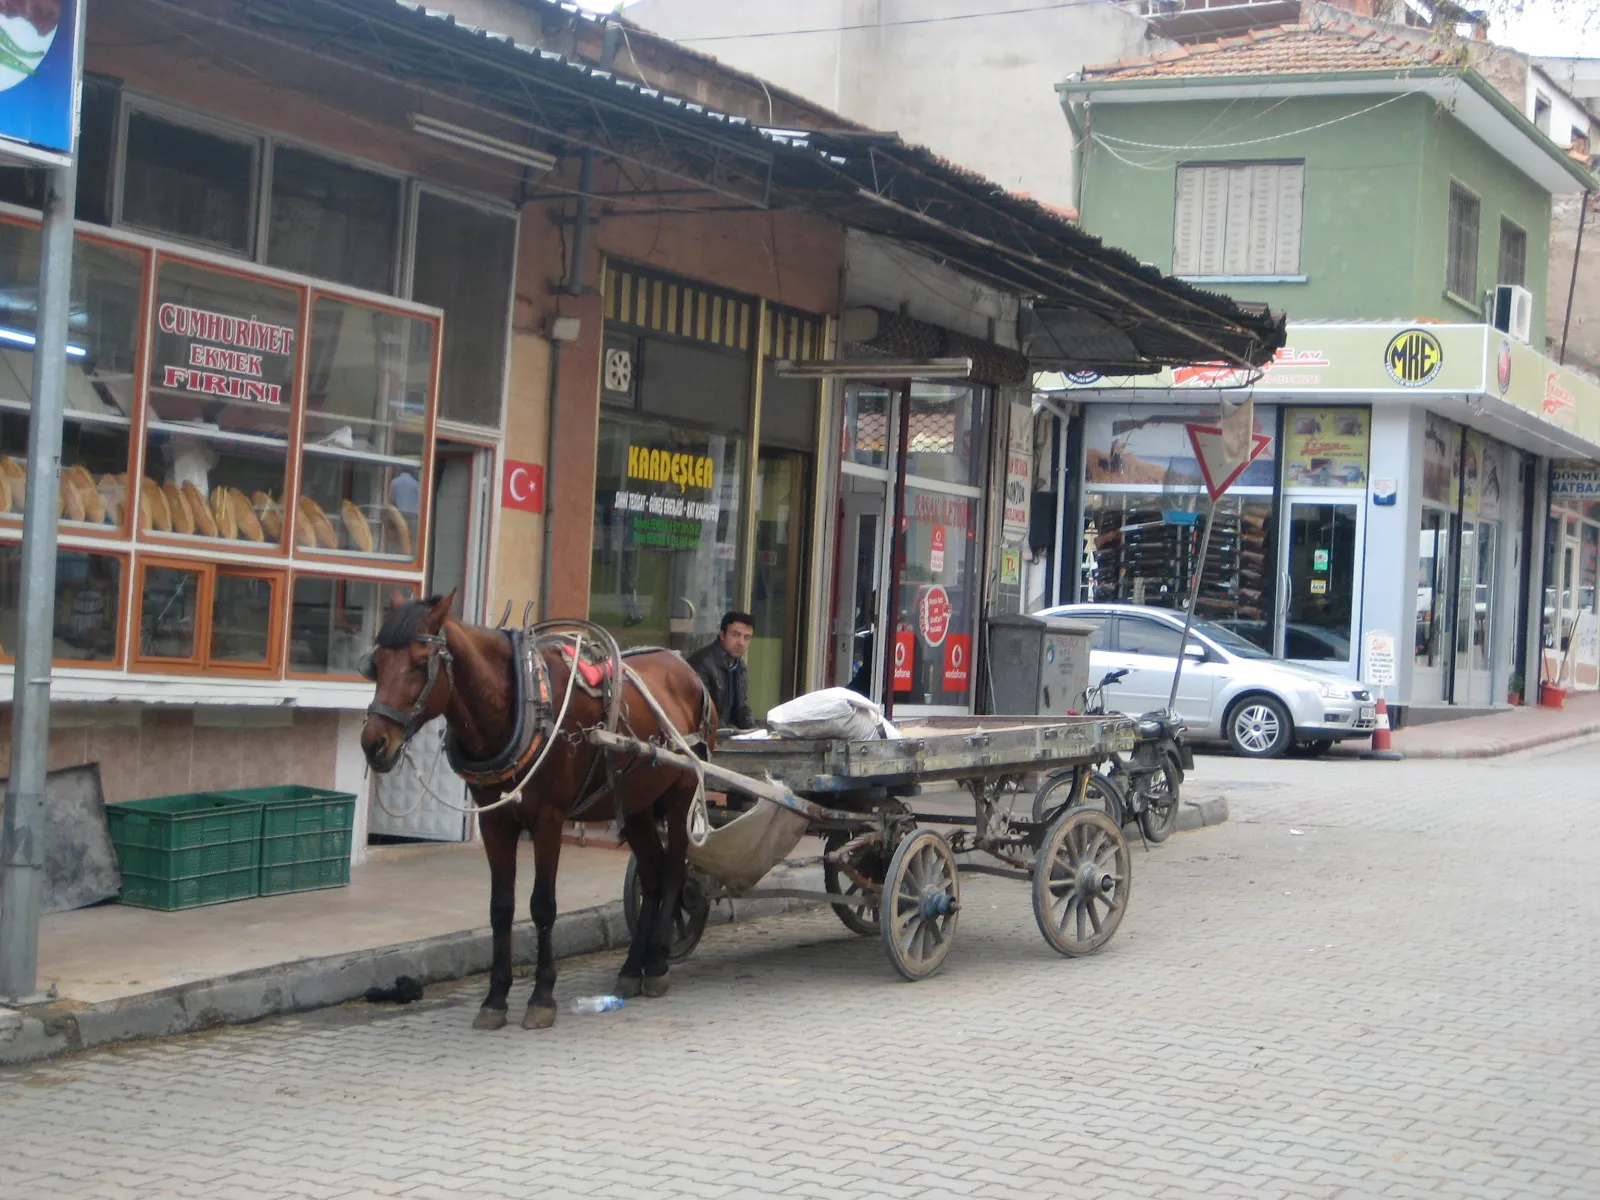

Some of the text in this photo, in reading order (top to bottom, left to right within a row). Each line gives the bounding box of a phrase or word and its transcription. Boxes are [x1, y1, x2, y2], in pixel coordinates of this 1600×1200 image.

[159, 303, 293, 355] CUMHURİYET
[190, 343, 262, 376] EKMEK
[1391, 334, 1435, 381] MKE
[163, 366, 281, 404] FIRINI
[627, 445, 714, 493] KARDEŞLER
[945, 669, 967, 679] vodafone
